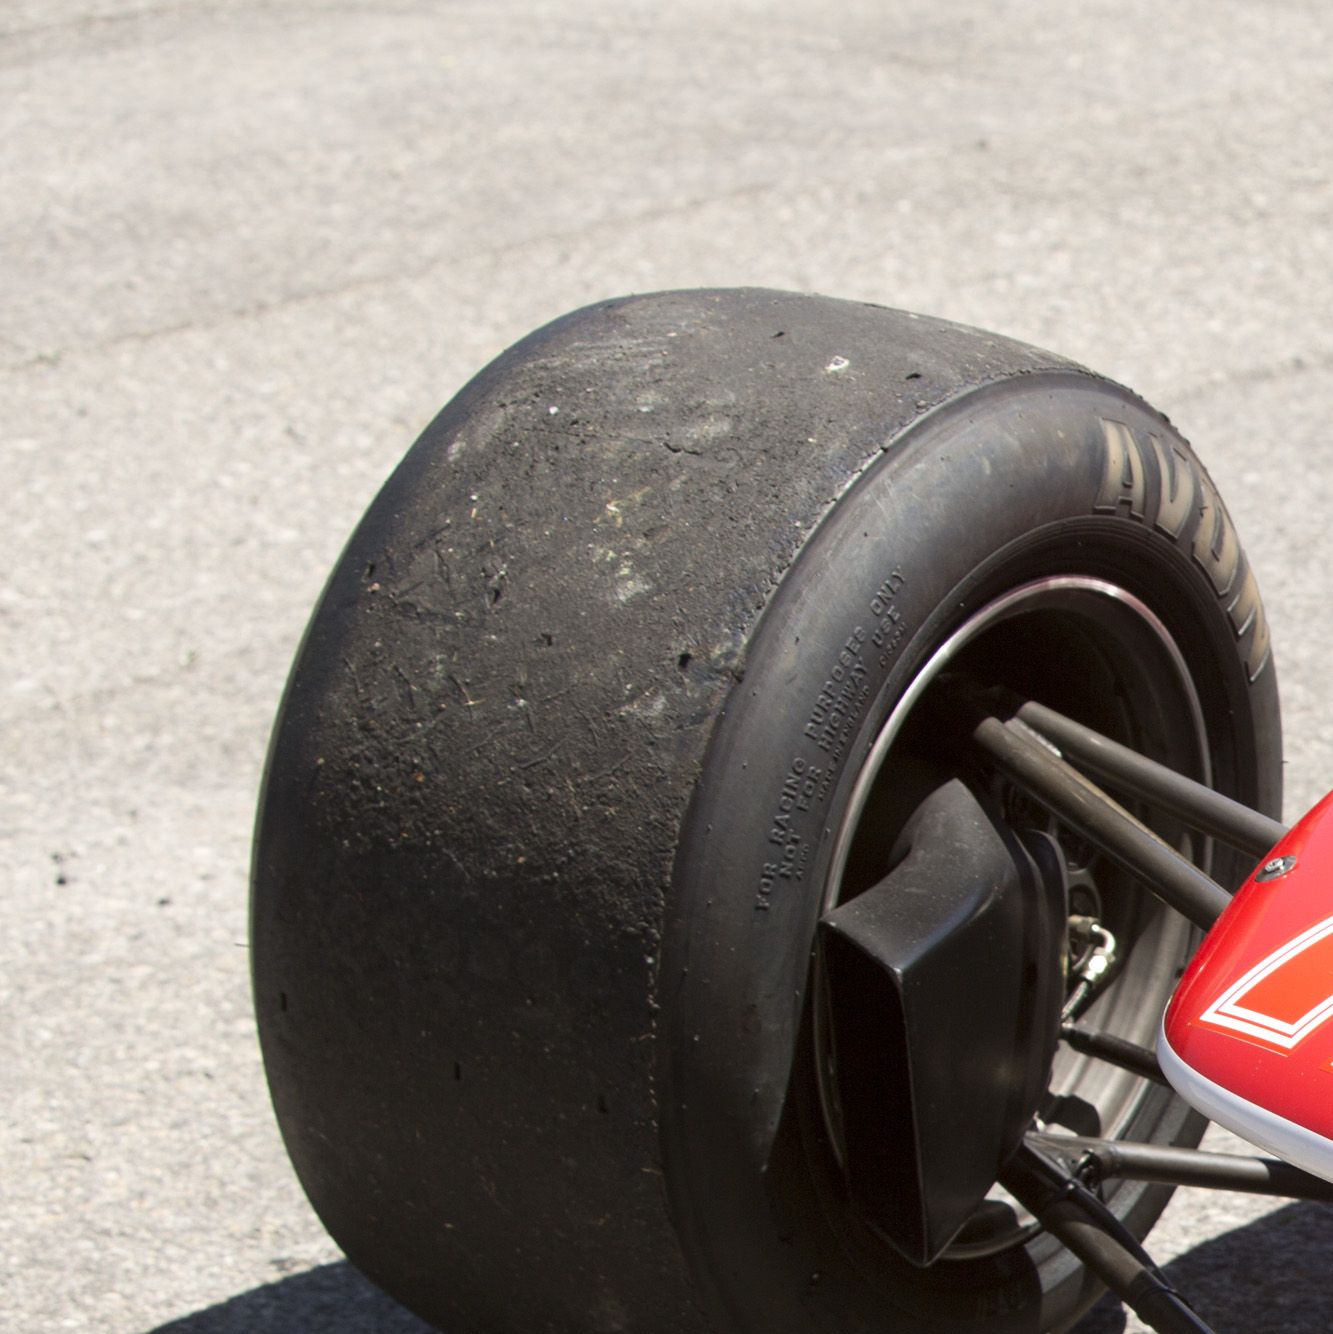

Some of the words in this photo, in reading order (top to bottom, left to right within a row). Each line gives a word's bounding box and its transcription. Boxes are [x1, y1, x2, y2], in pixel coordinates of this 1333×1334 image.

[757, 862, 778, 911] FOR
[770, 757, 807, 846] RACING
[804, 625, 866, 741] PURPOSES
[870, 565, 905, 617] ONLY
[778, 828, 802, 880] NOT
[797, 766, 822, 813] FOR
[818, 656, 868, 753] HIGHWAY
[872, 605, 901, 650] USE
